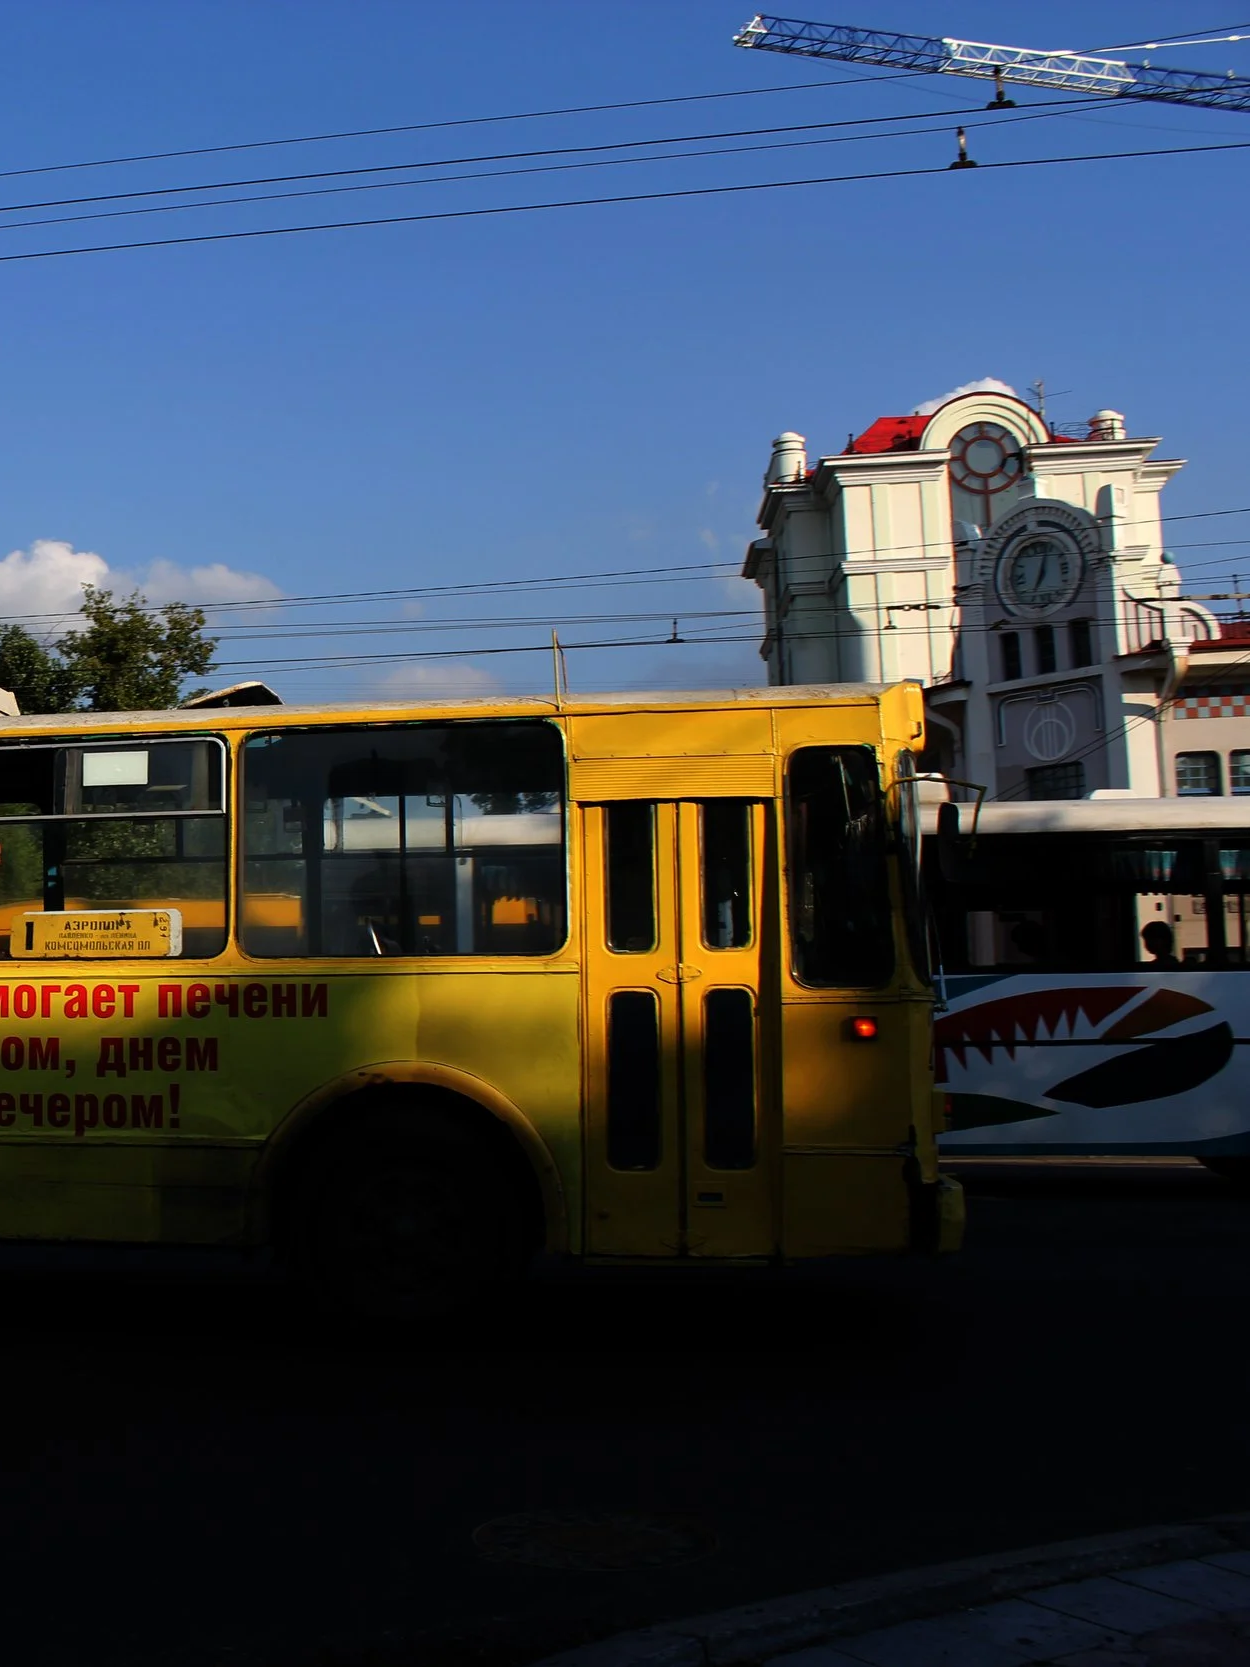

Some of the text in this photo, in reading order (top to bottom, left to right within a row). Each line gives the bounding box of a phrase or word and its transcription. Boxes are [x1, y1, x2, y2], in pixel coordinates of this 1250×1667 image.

[44, 940, 134, 950] КОМСОМОЛЬСКАЯ
[158, 983, 328, 1018] печени
[96, 1036, 218, 1078] днем
